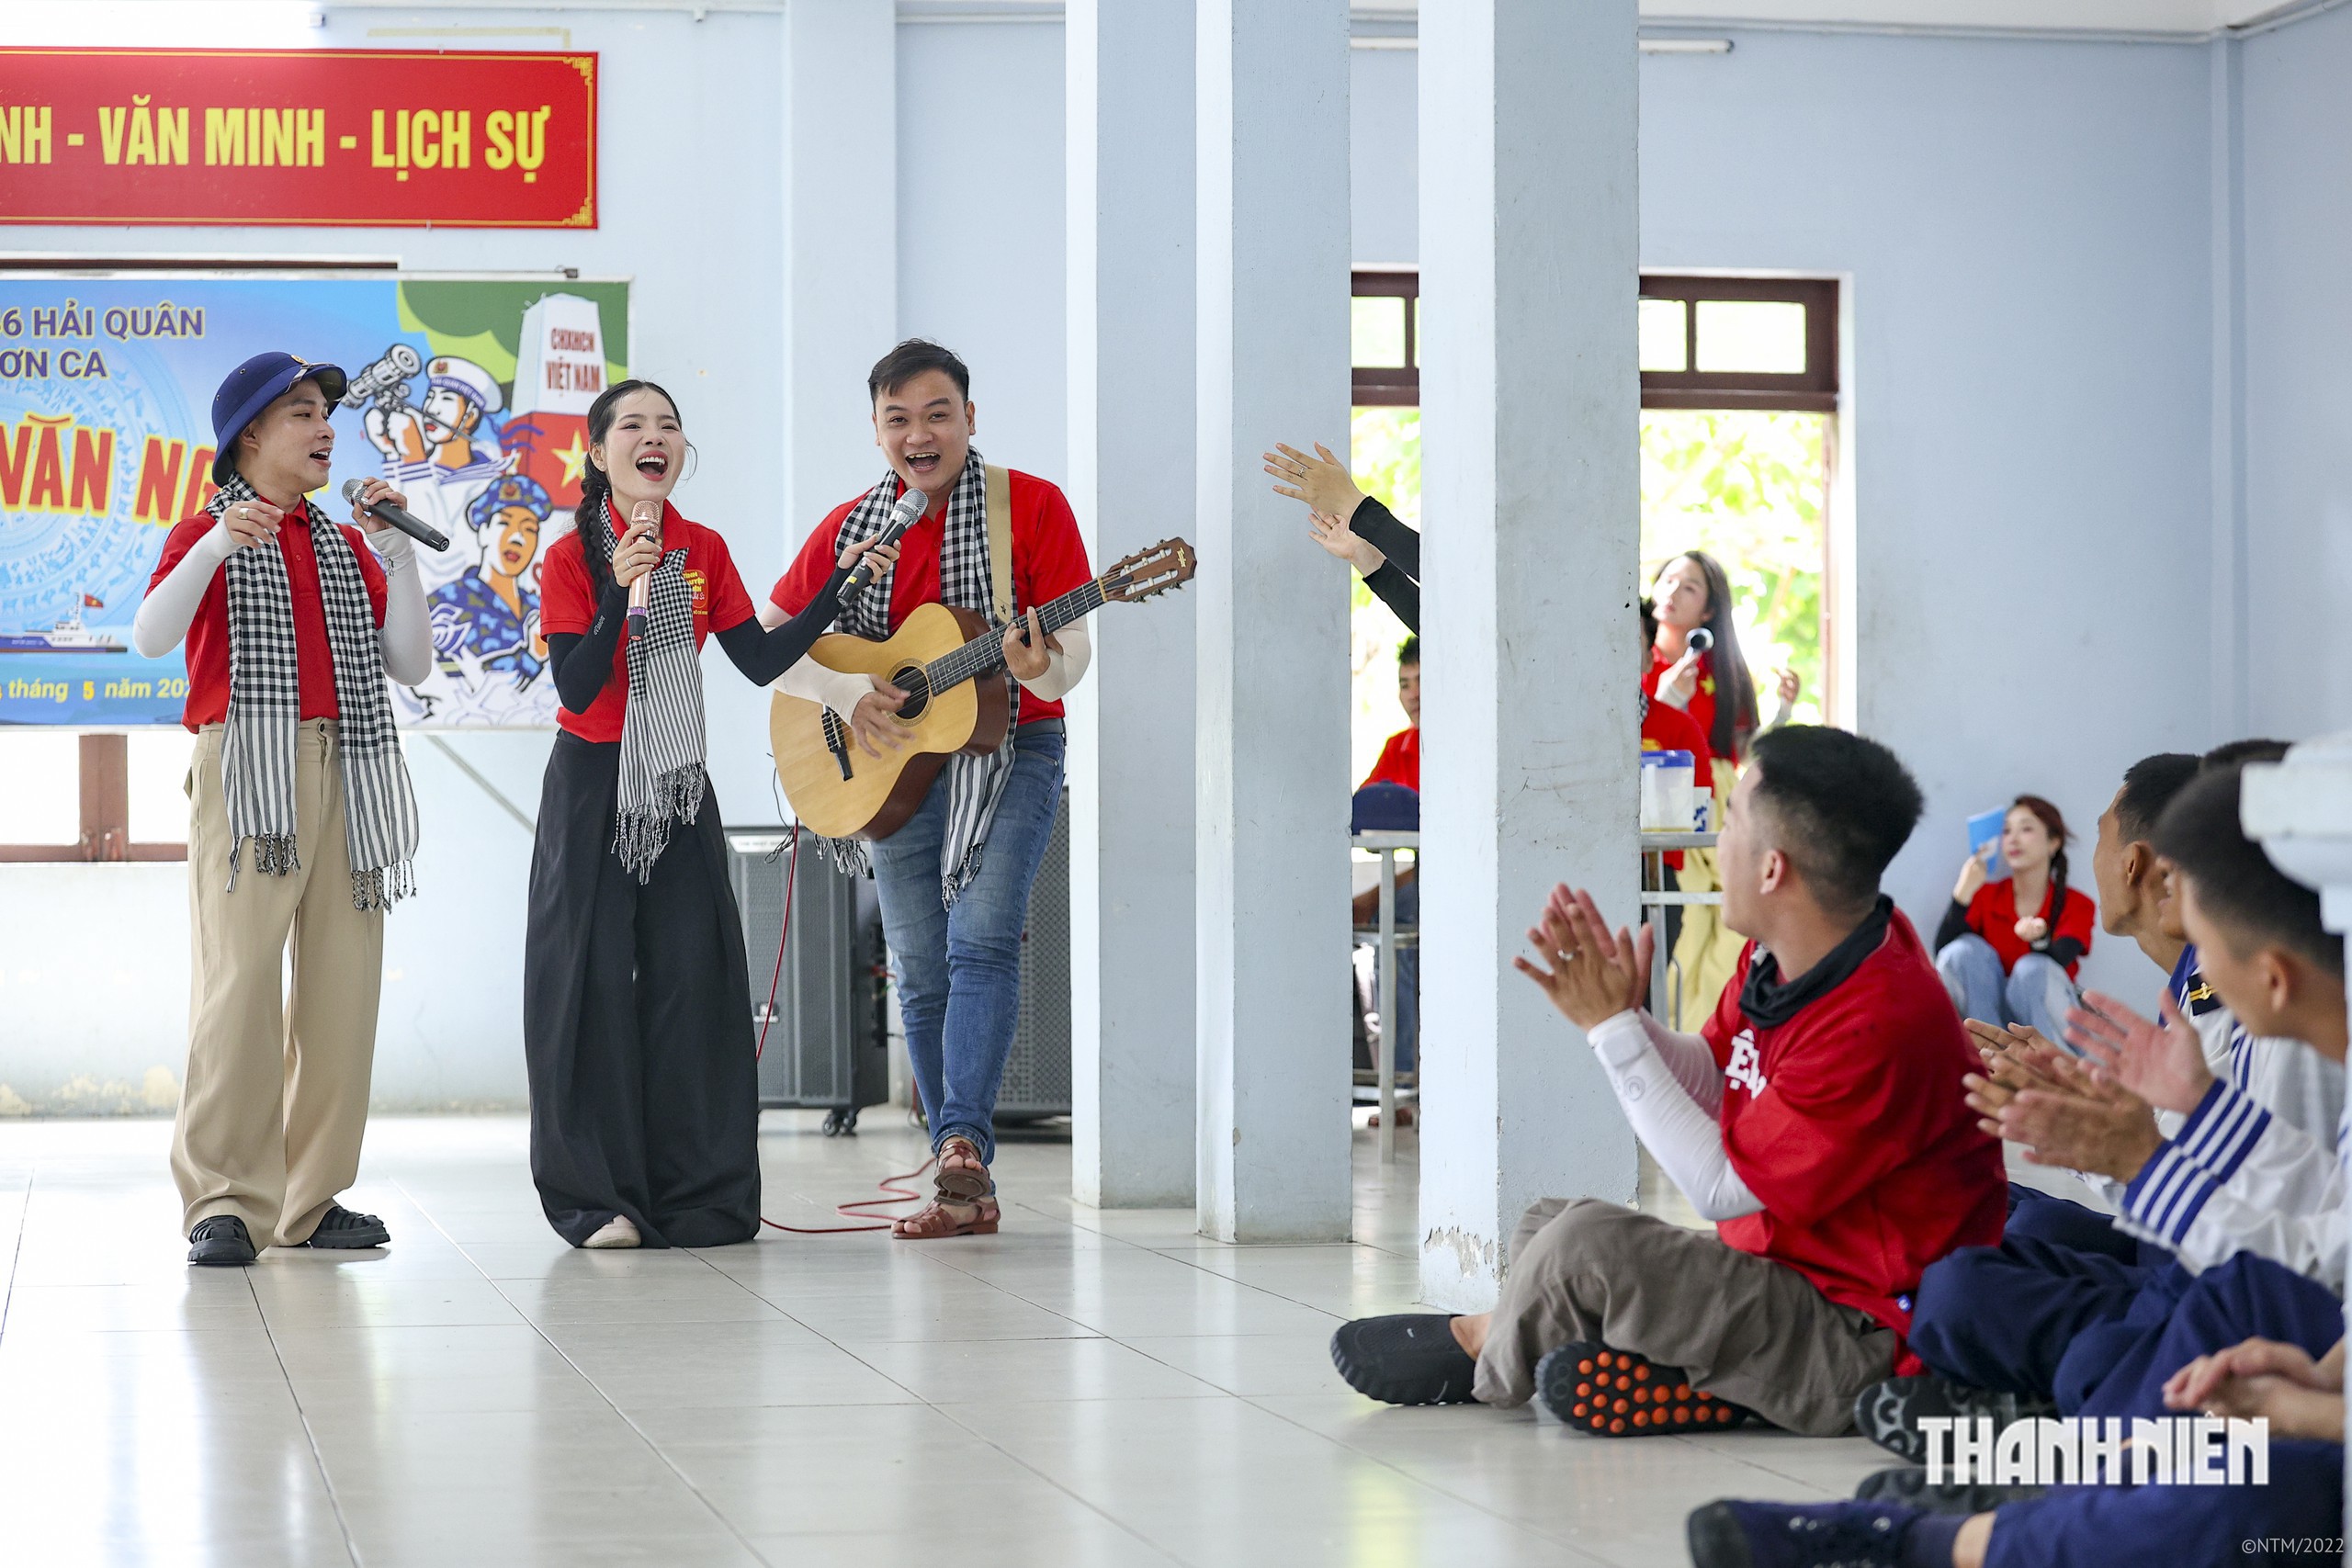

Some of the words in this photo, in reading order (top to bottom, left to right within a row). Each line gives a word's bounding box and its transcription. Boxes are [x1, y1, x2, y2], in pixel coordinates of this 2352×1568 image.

[98, 94, 189, 165] VĂN
[205, 107, 325, 167] MINH
[371, 108, 470, 182] LỊCH
[484, 105, 551, 183] SỰ
[32, 299, 96, 339] HẢI
[104, 300, 205, 341] QUÂN
[59, 349, 109, 379] CA
[546, 355, 571, 397] VIỆT
[574, 363, 600, 393] NAM
[0, 412, 114, 514] VĂN
[135, 435, 218, 524] NG
[8, 677, 69, 704] tháng
[83, 680, 96, 701] 5
[105, 677, 152, 698] năm
